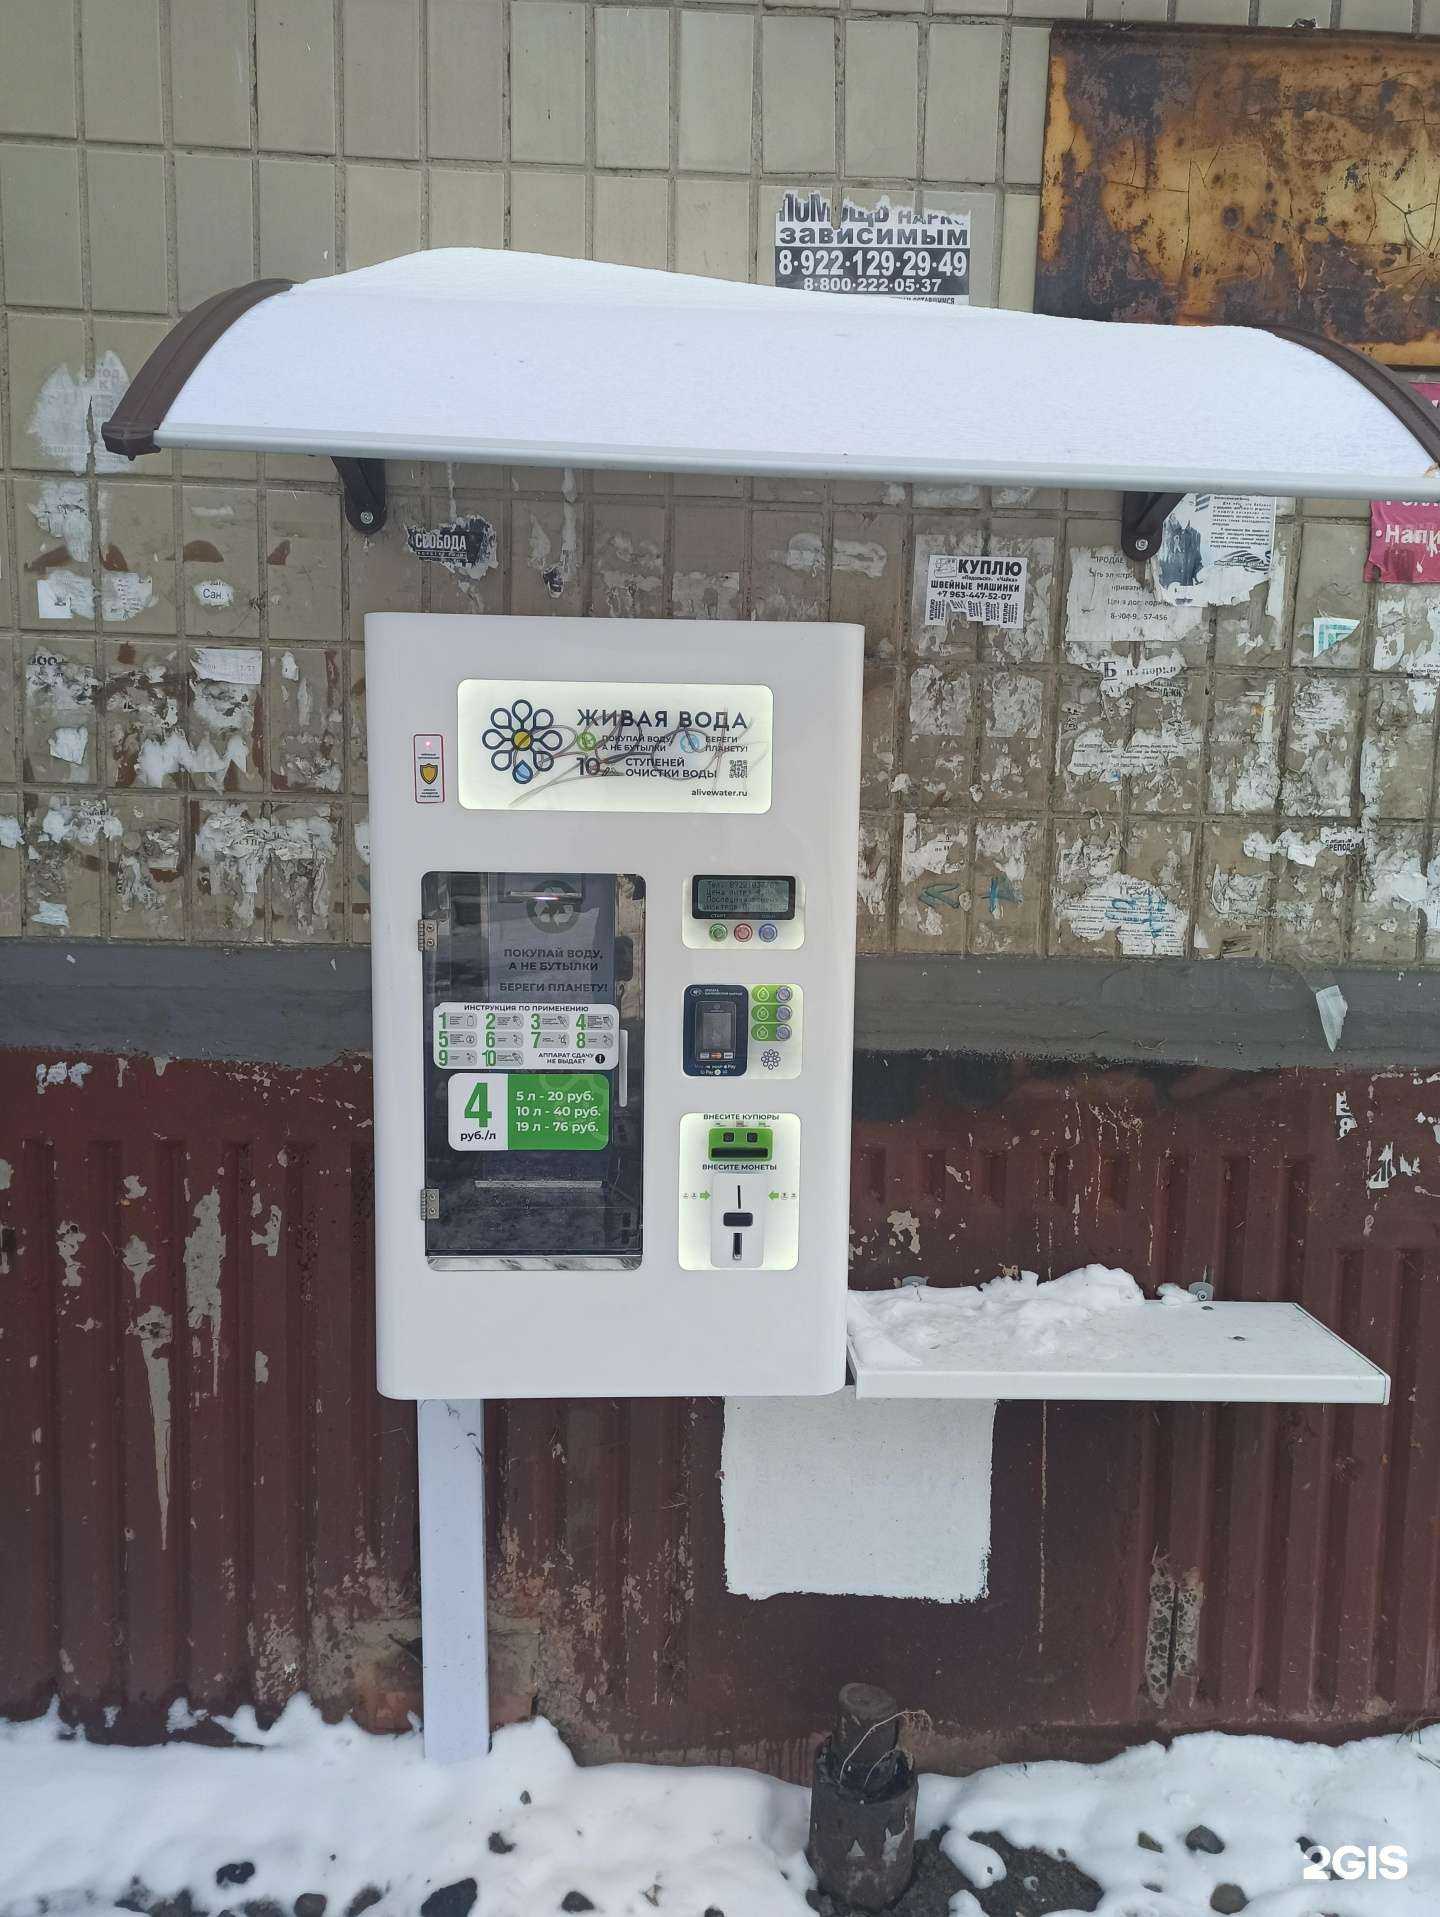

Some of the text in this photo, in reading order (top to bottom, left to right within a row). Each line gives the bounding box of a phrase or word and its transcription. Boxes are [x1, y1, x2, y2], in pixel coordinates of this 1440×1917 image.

[415, 533, 467, 551] СВОБОДА
[957, 559, 1022, 577] КУПЛЮ
[930, 580, 1020, 593] ШВЕЙНЫЕ МАШИНКИ
[576, 708, 748, 731] ЖИВАЯ ВОДА
[601, 734, 645, 744] ПОКУПАЙ
[705, 736, 738, 744] БЕРЕГИ
[601, 744, 667, 753] А НЕ БУТЫЛКИ
[576, 757, 601, 777] 10
[625, 756, 685, 767] СТУПЕНЕЙ
[625, 769, 718, 779] ОЧИСТКИ ВОДЫ
[691, 788, 748, 797] alivewater.ru
[503, 946, 603, 960] ПОКУПАЙ ВОДУ,
[508, 962, 599, 971] А НЕ БУТЫЛКИ
[499, 982, 608, 993] БЕРЕГИ ПЛАНЕТУ!
[464, 1004, 517, 1012] ИНСТРУКЦИЯ
[438, 1012, 447, 1029] 1
[485, 1012, 496, 1030] 2
[530, 1013, 541, 1030] 3
[575, 1013, 587, 1031] 4
[438, 1031, 586, 1049] 5 6 7 8
[438, 1049, 497, 1067] 9 10
[516, 1091, 524, 1101] 5
[527, 1092, 536, 1101] л
[547, 1091, 564, 1101] 20
[567, 1091, 595, 1103] руб.
[464, 1082, 493, 1128] 4
[515, 1106, 530, 1116] 10
[532, 1107, 541, 1116] л
[553, 1106, 571, 1116] 40
[574, 1106, 601, 1118] руб.
[515, 1121, 530, 1132] 19
[531, 1122, 541, 1132] л
[552, 1121, 569, 1132] 76
[571, 1121, 599, 1134] руб.
[460, 1131, 496, 1142] руб./л
